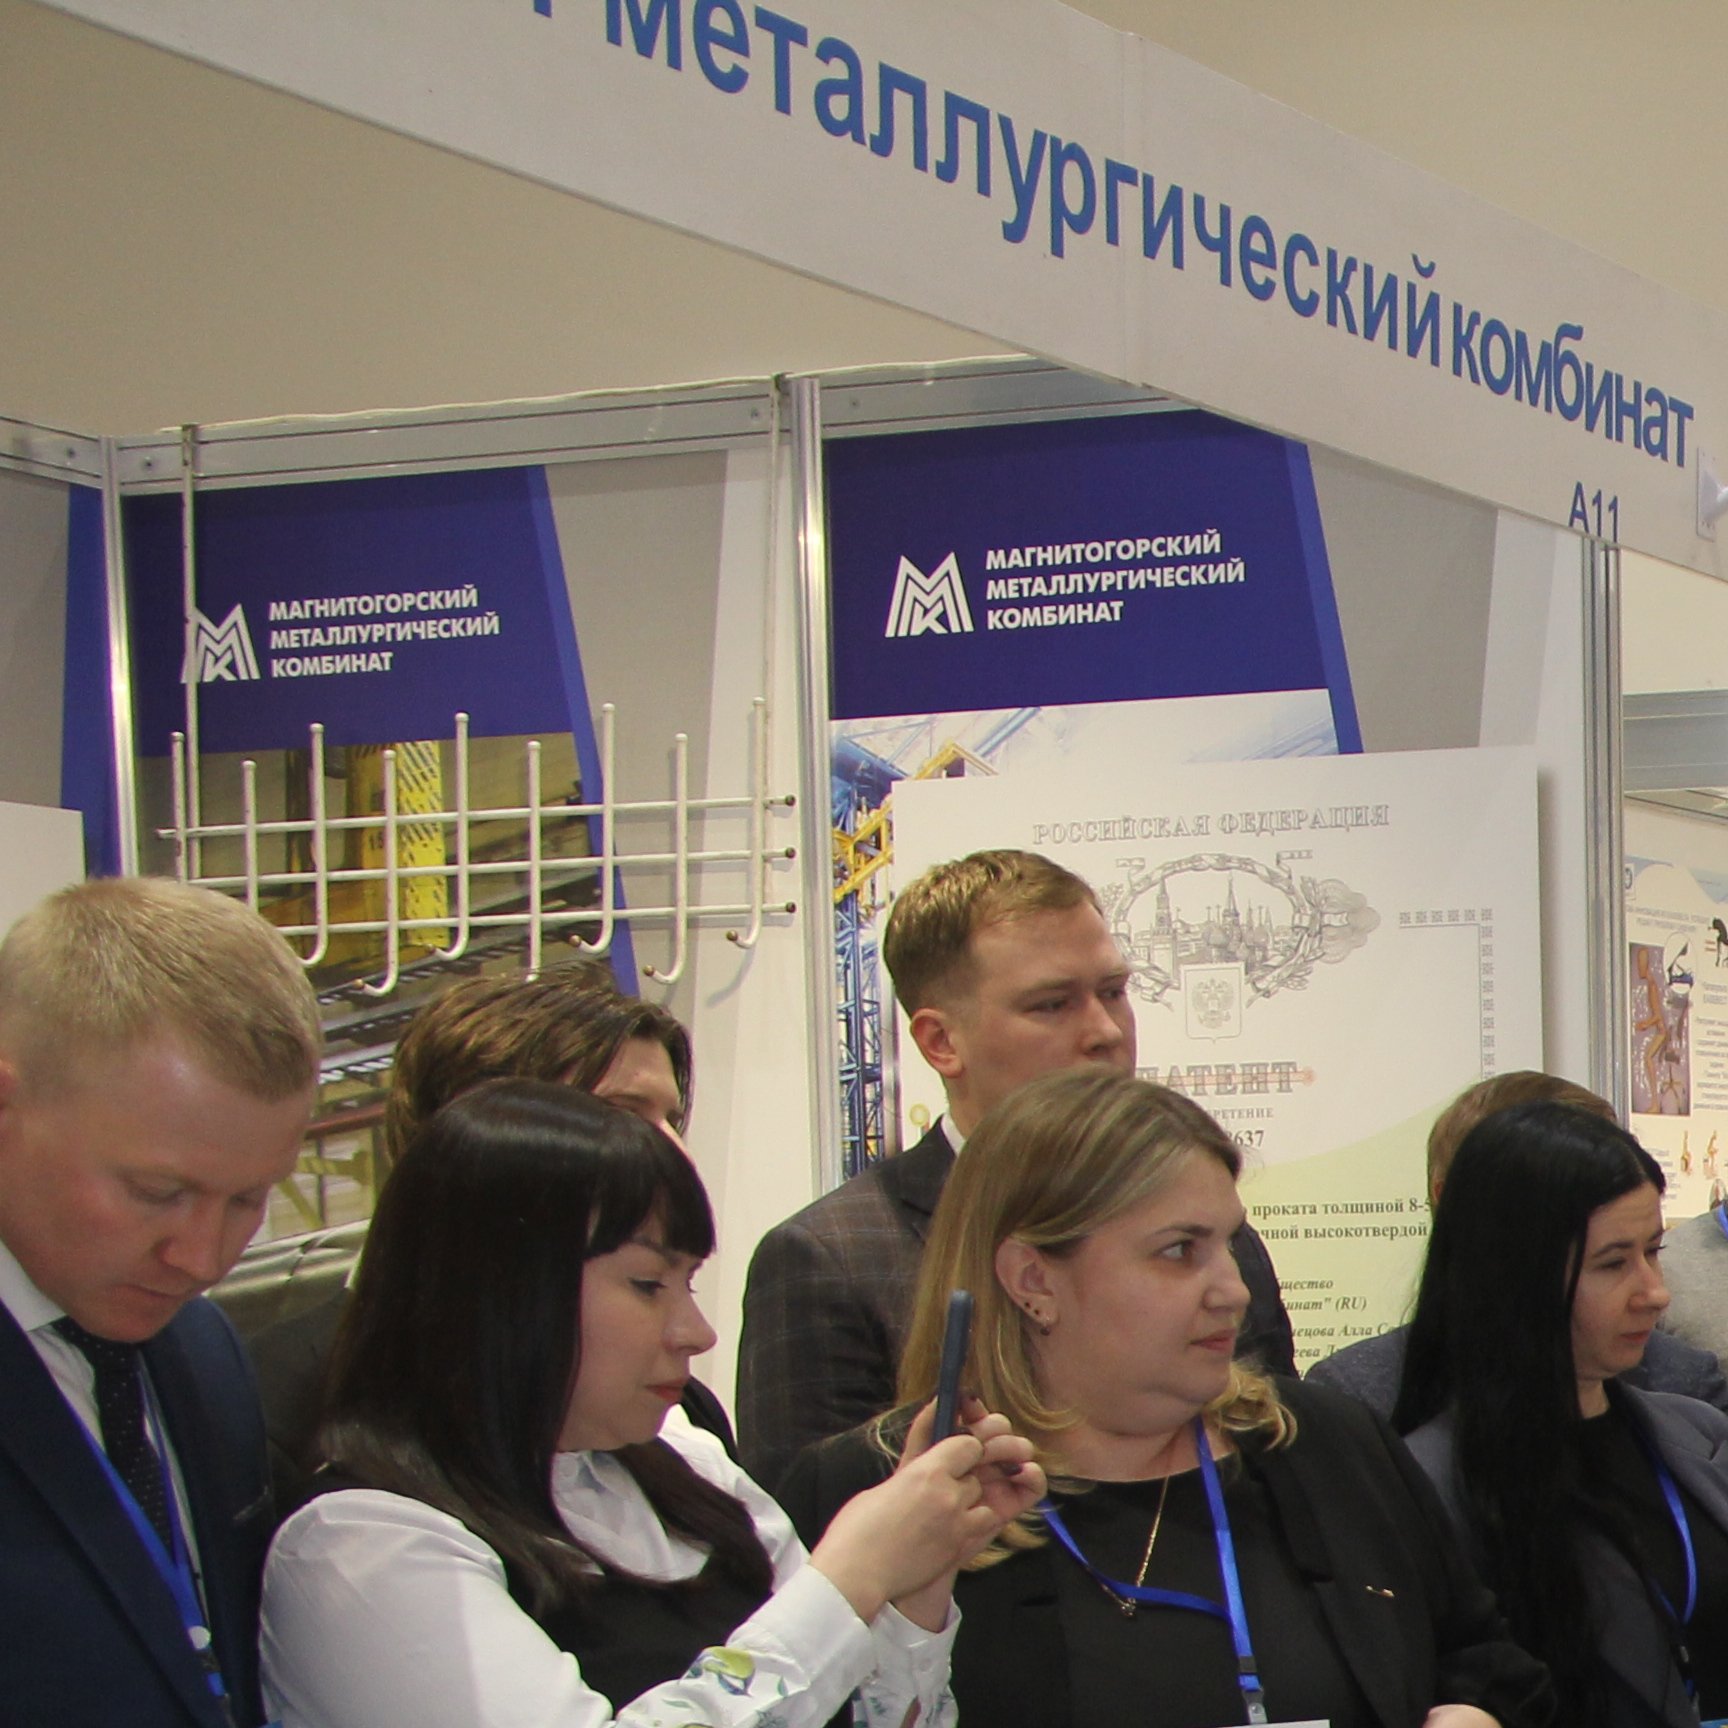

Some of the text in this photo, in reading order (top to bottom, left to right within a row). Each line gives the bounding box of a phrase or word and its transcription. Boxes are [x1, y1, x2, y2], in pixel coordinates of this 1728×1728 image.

[1453, 303, 1694, 469] комбинат
[985, 530, 1222, 570] МАГНИТОГОРСКИЙ
[986, 557, 1245, 600] МЕТАЛЛУРГИЧЕСКИЙ
[268, 584, 478, 623] МАГНИТОГОРСКИЙ
[986, 602, 1124, 631] КОМБИНАТ
[269, 611, 500, 650] МЕТАЛЛУРГИЧЕСКИЙ
[270, 651, 394, 678] КОМБИНАТ
[1032, 804, 1389, 844] РОССИЙСКАЯ ФЕДЕРАЦИЯ
[1208, 1107, 1274, 1120] РЕТЕНИЕ
[1227, 1130, 1264, 1148] 637
[1253, 1202, 1404, 1220] проката толщиной
[1259, 1222, 1427, 1241] чной высокотвердой
[1278, 1277, 1333, 1293] щество
[1339, 1324, 1373, 1337] Алла
